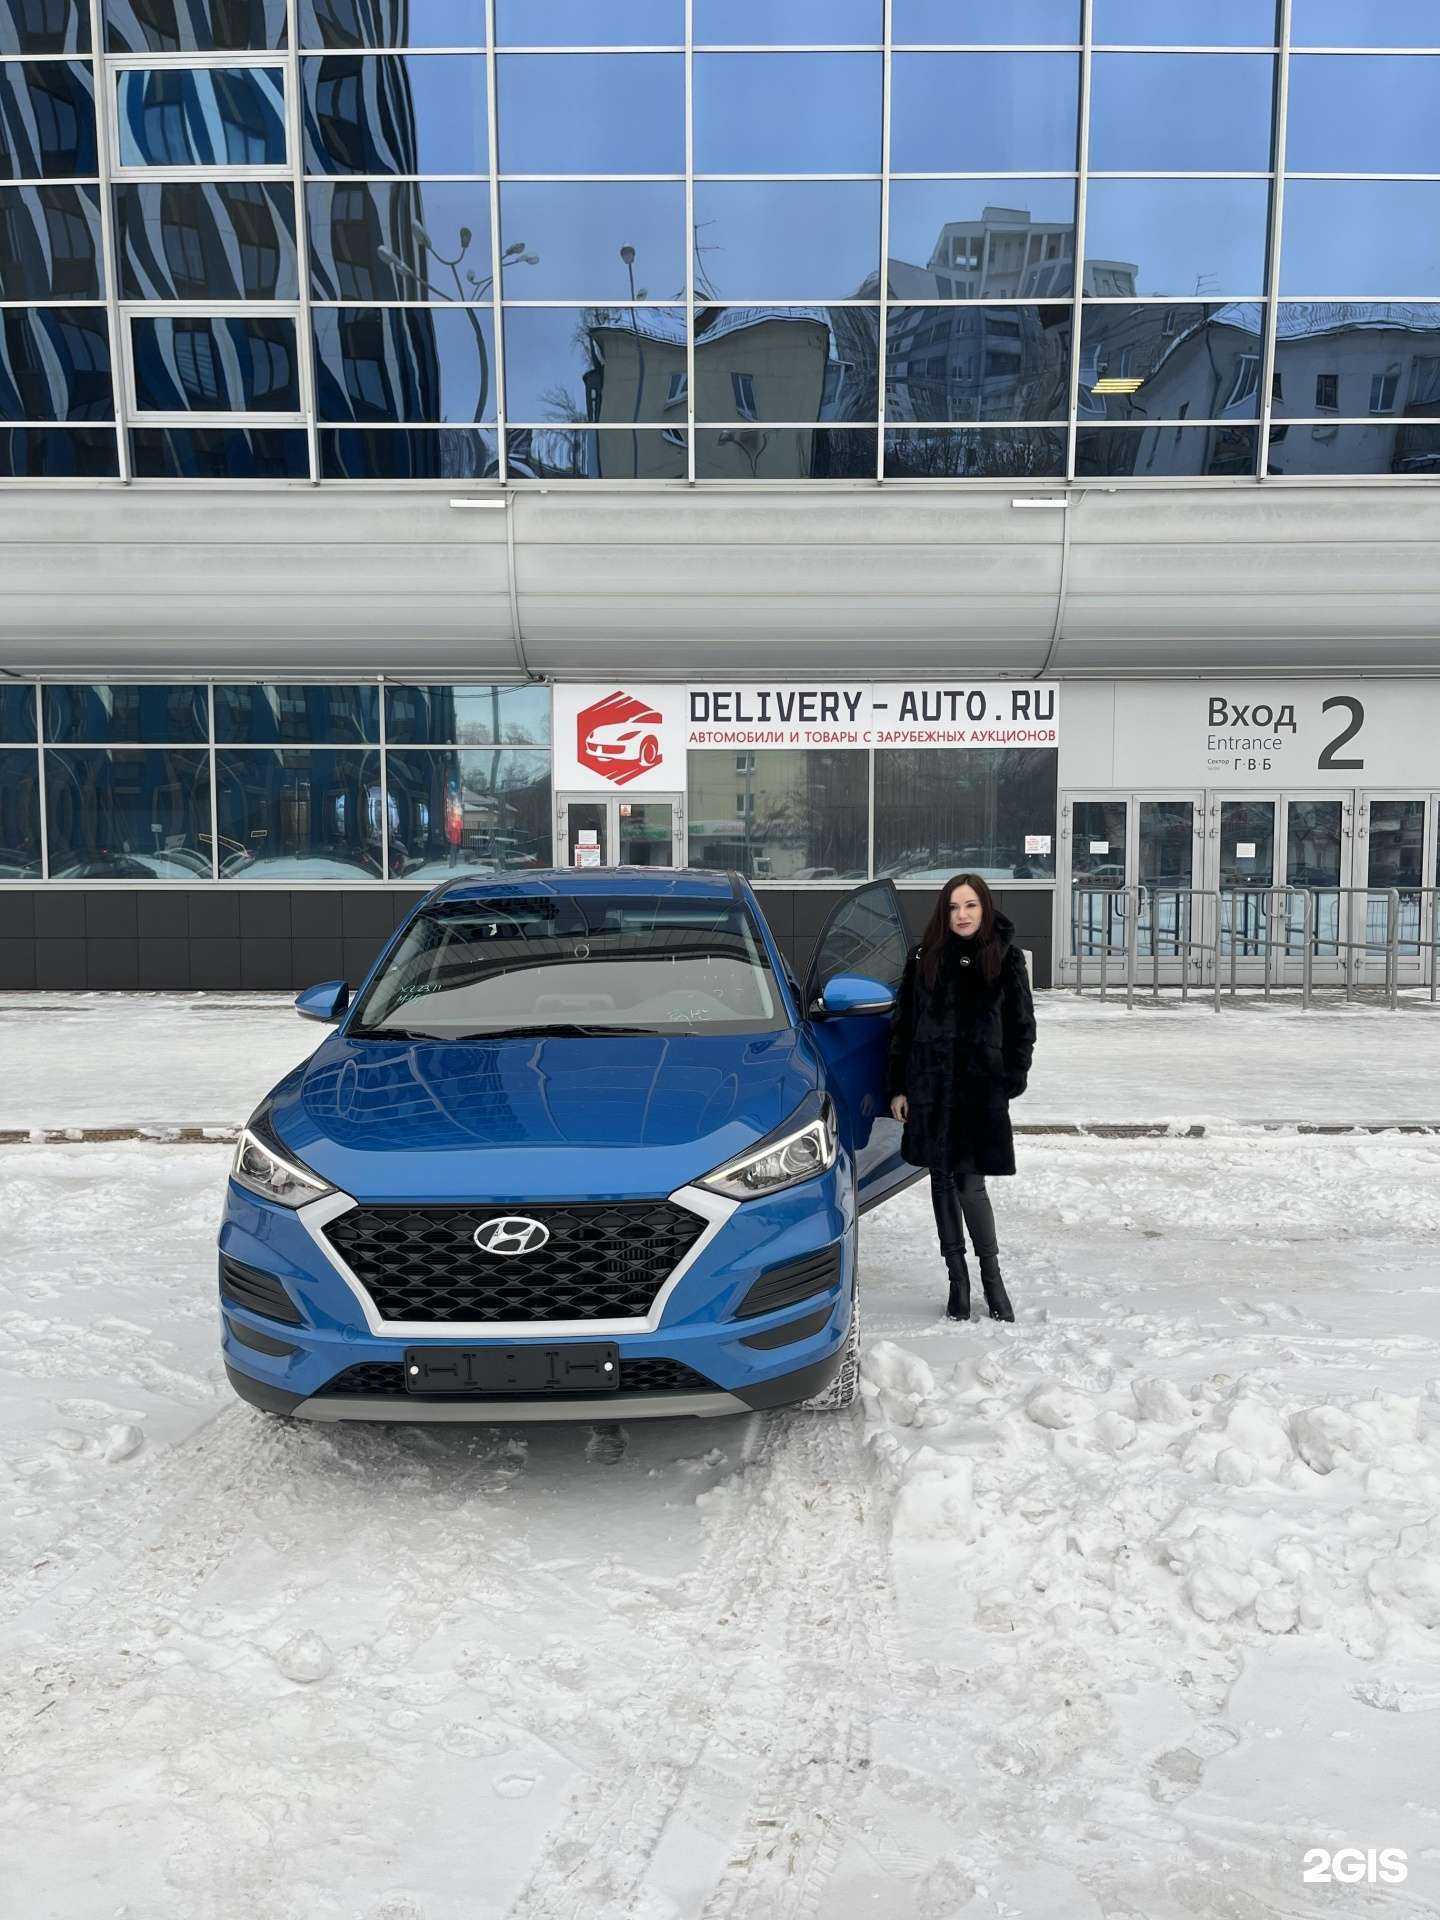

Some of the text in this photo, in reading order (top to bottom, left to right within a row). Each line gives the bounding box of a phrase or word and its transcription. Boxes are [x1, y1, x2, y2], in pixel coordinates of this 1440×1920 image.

[1208, 697, 1297, 734] Вход
[689, 729, 1056, 744] АВТОМОБИЛИ И ТОВАРЫ С ЗАРУБЕЖНЫХ АУКЦИОНОВ
[1207, 734, 1283, 751] Entrance
[1317, 695, 1365, 770] 2
